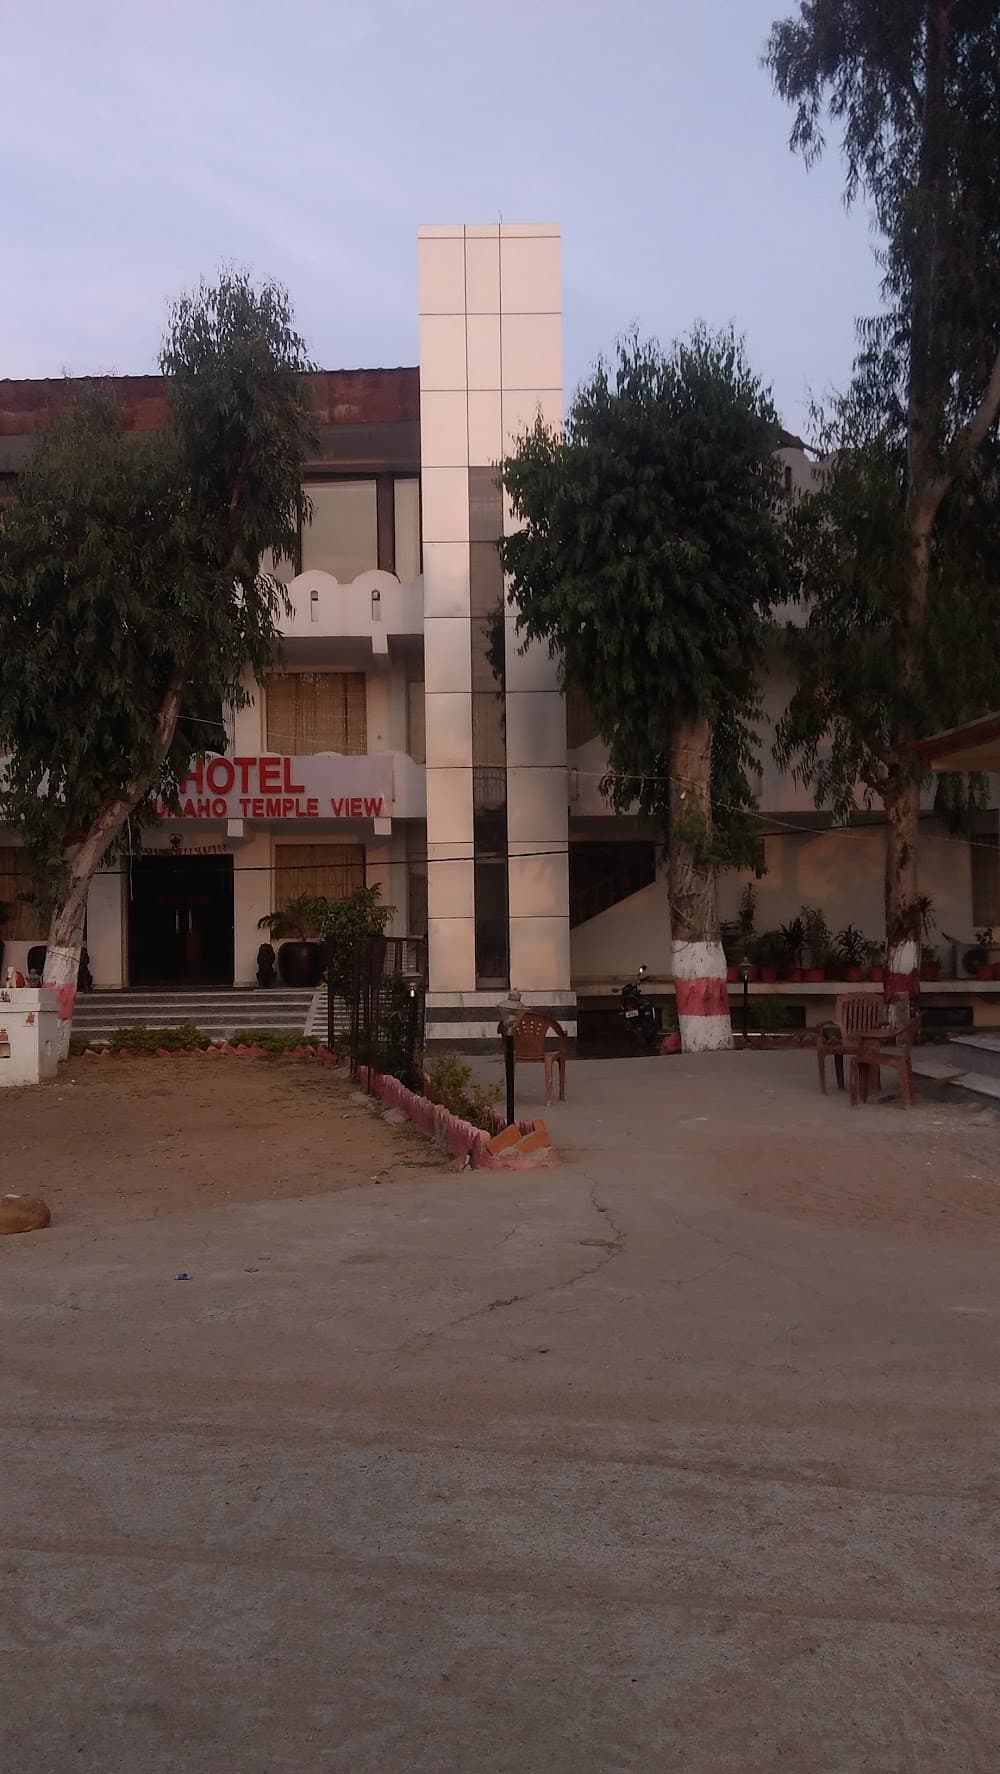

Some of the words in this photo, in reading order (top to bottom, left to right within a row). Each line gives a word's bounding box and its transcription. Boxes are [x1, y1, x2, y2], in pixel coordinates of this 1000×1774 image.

[180, 757, 305, 794] HOTEL
[239, 798, 319, 817] TEMPLE
[331, 797, 383, 817] VIEW
